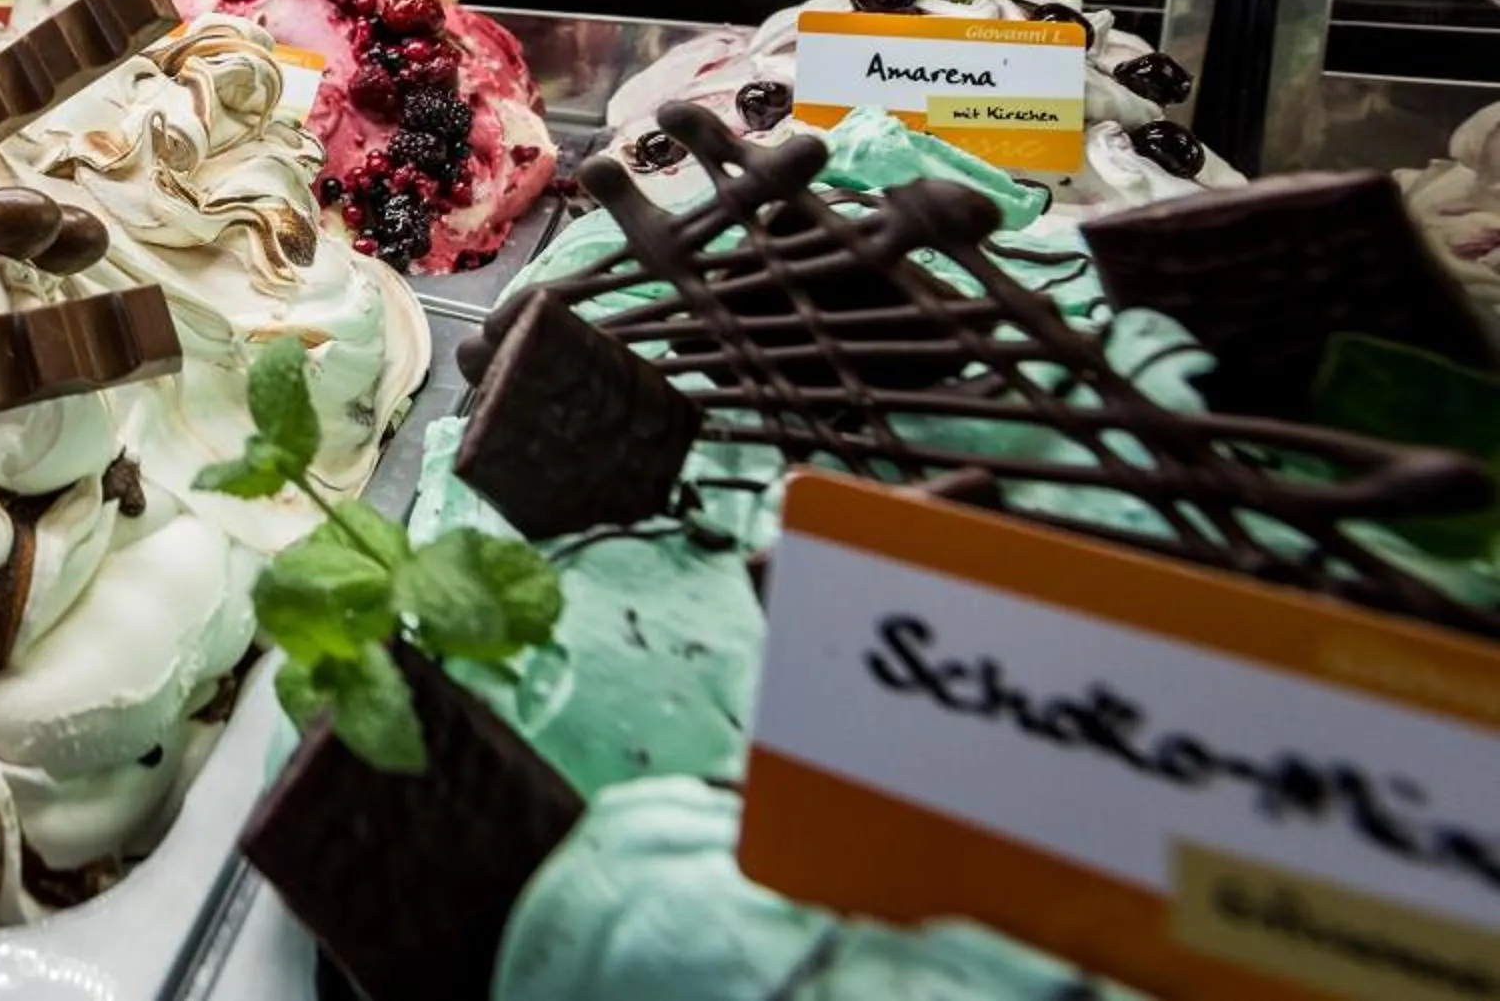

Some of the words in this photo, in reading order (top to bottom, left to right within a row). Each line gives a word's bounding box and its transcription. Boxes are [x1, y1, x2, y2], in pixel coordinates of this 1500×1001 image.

[965, 24, 1047, 44] Giovanni
[865, 52, 998, 88] Amarena
[953, 106, 981, 120] mit
[986, 105, 1060, 122] Kirschen
